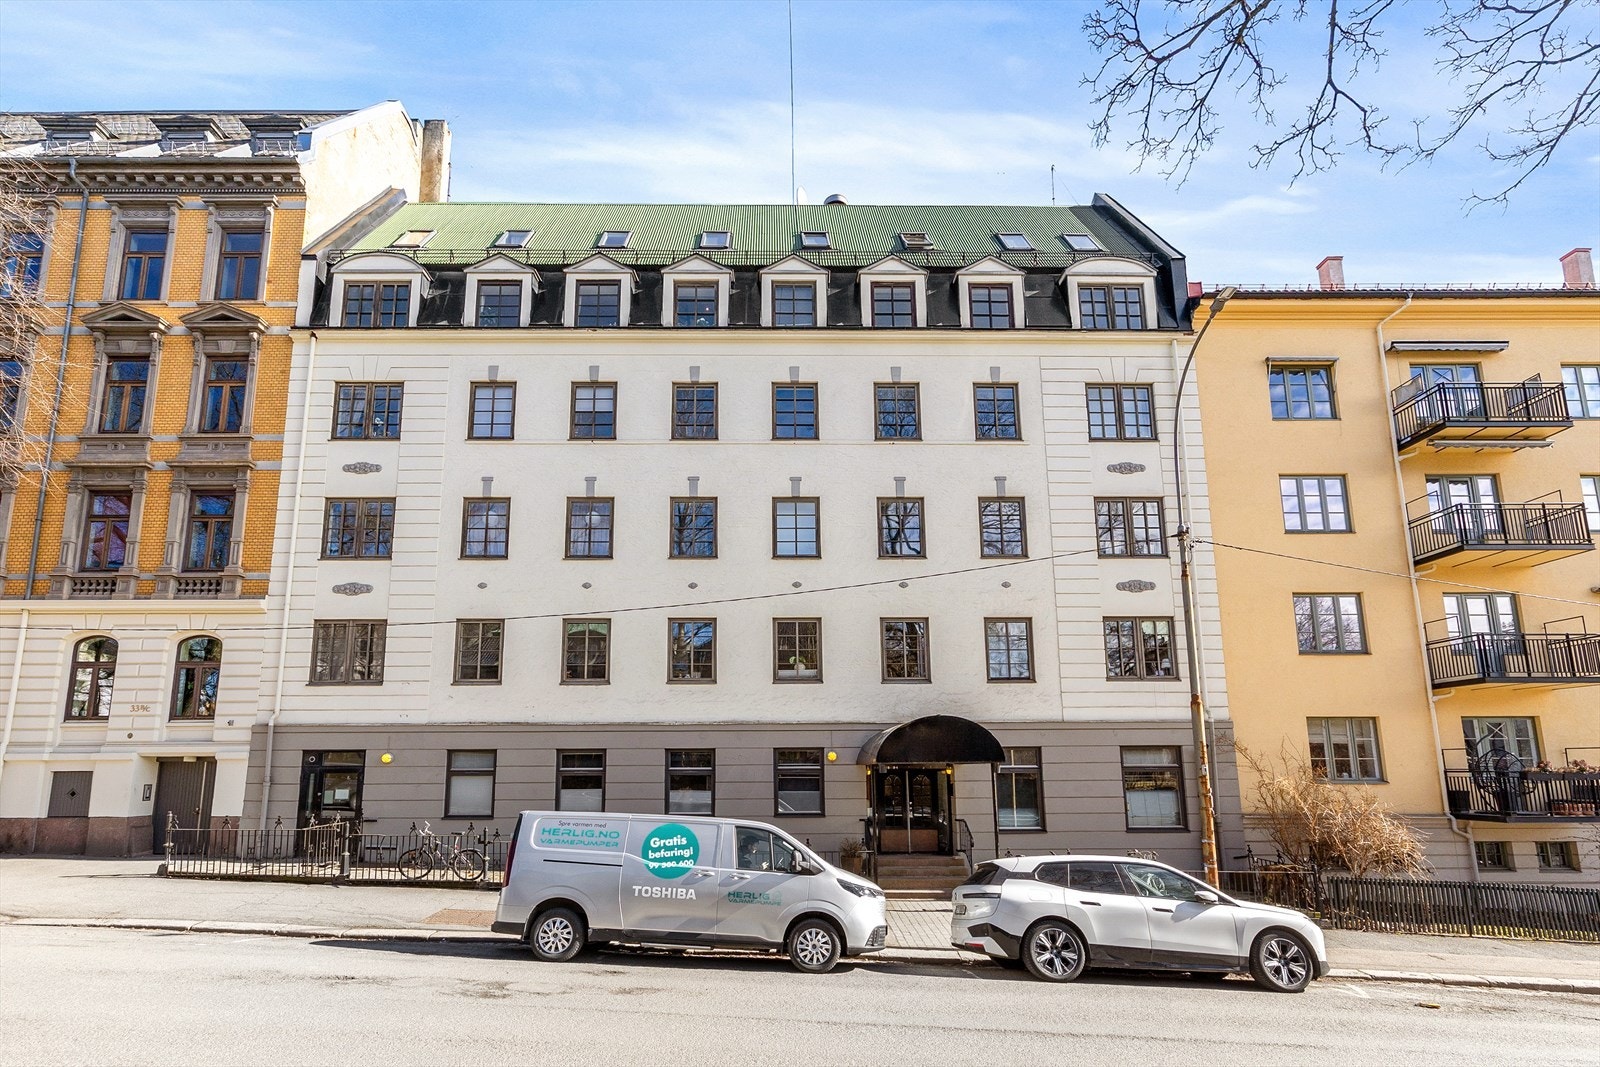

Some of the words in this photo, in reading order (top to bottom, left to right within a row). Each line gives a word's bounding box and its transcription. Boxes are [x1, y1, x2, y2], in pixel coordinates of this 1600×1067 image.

[558, 820, 571, 828] Spre
[541, 828, 620, 839] HERLIG.NO
[540, 838, 619, 848] VARMEPUMPER
[650, 835, 688, 848] Gratis
[648, 846, 694, 859] befaring!
[632, 885, 697, 900] TOSHIBA
